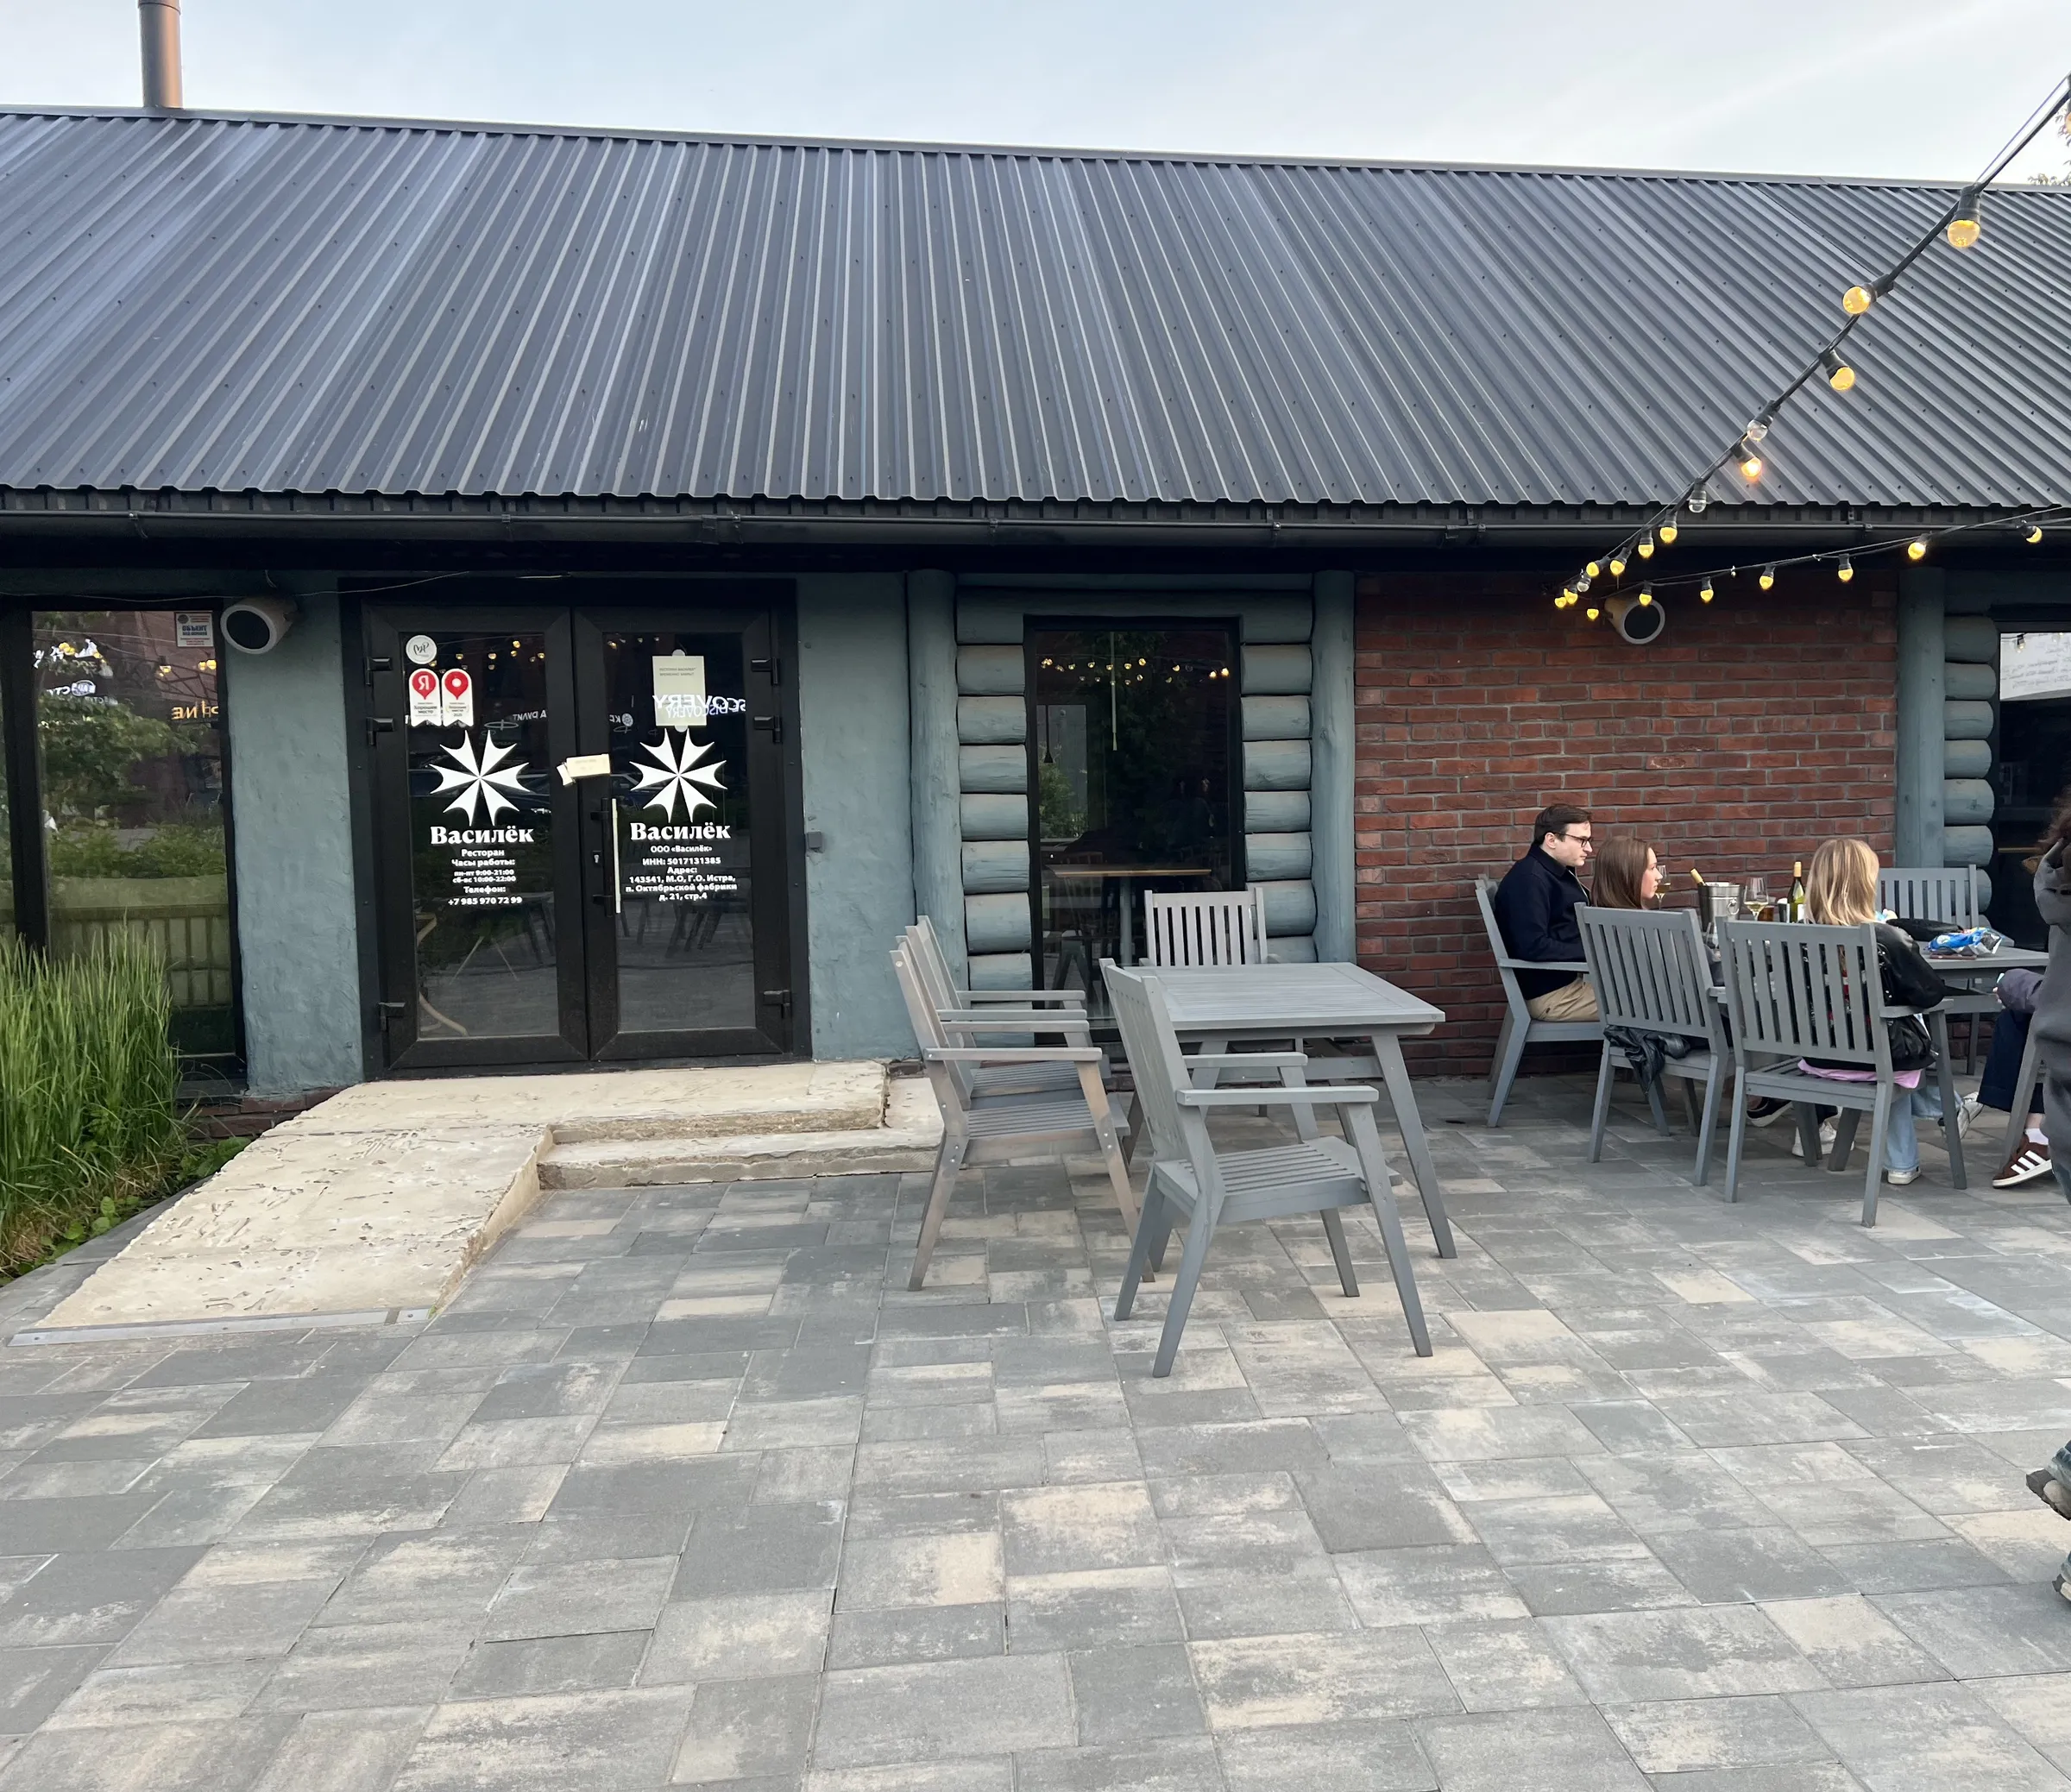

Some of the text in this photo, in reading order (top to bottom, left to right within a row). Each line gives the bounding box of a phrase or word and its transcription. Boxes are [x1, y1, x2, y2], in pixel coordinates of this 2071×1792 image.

[431, 826, 534, 844] Василёк
[630, 822, 731, 840] Василёк
[462, 849, 504, 858] Ресторан
[477, 858, 515, 867] работы:
[463, 885, 507, 894] Телефон:
[636, 883, 696, 892] Октябрьской
[697, 883, 737, 892] фабрики
[684, 892, 707, 902] стр.4
